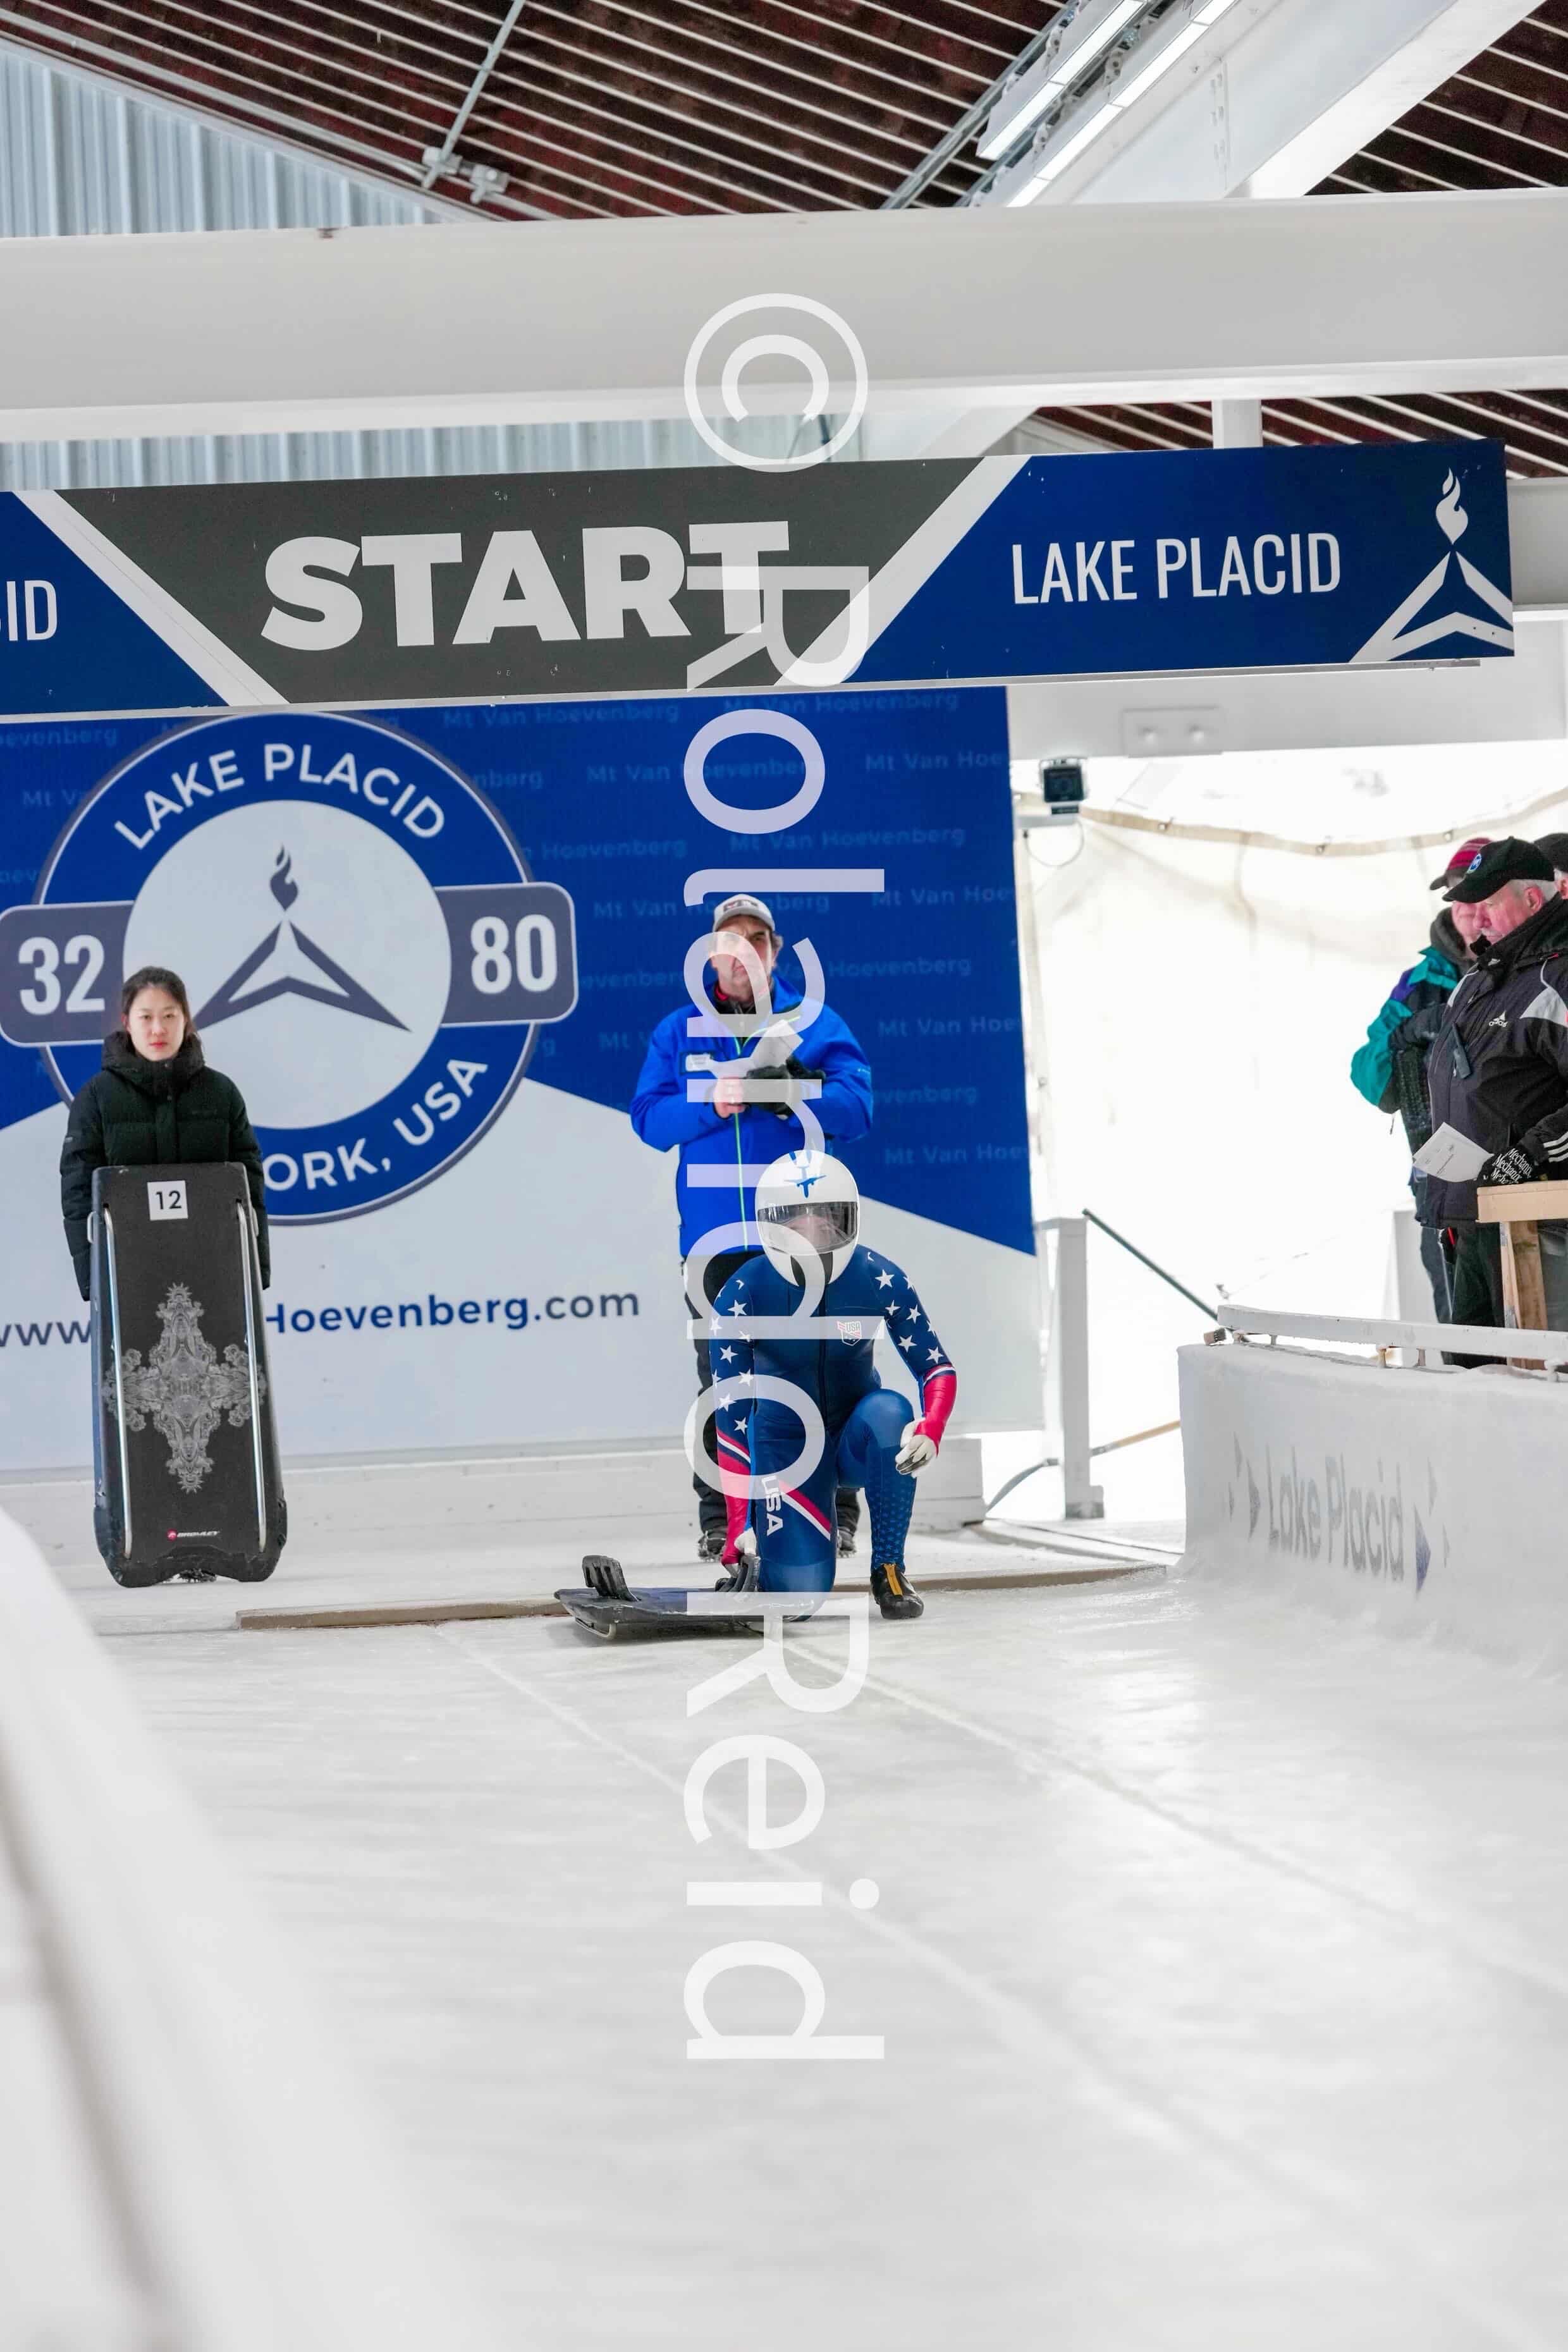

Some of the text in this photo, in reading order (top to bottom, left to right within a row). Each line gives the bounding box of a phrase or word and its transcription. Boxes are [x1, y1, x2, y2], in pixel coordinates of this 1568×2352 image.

[0, 580, 58, 641] ID
[260, 520, 790, 651] START
[1012, 532, 1341, 604] LAKE PLACID
[114, 744, 444, 850] LAKE PLACID
[18, 914, 558, 1016] 32 80
[393, 1059, 488, 1146] USA
[155, 1191, 182, 1210] 12
[761, 1475, 783, 1536] USA
[1266, 1443, 1404, 1581] Lake Placid
